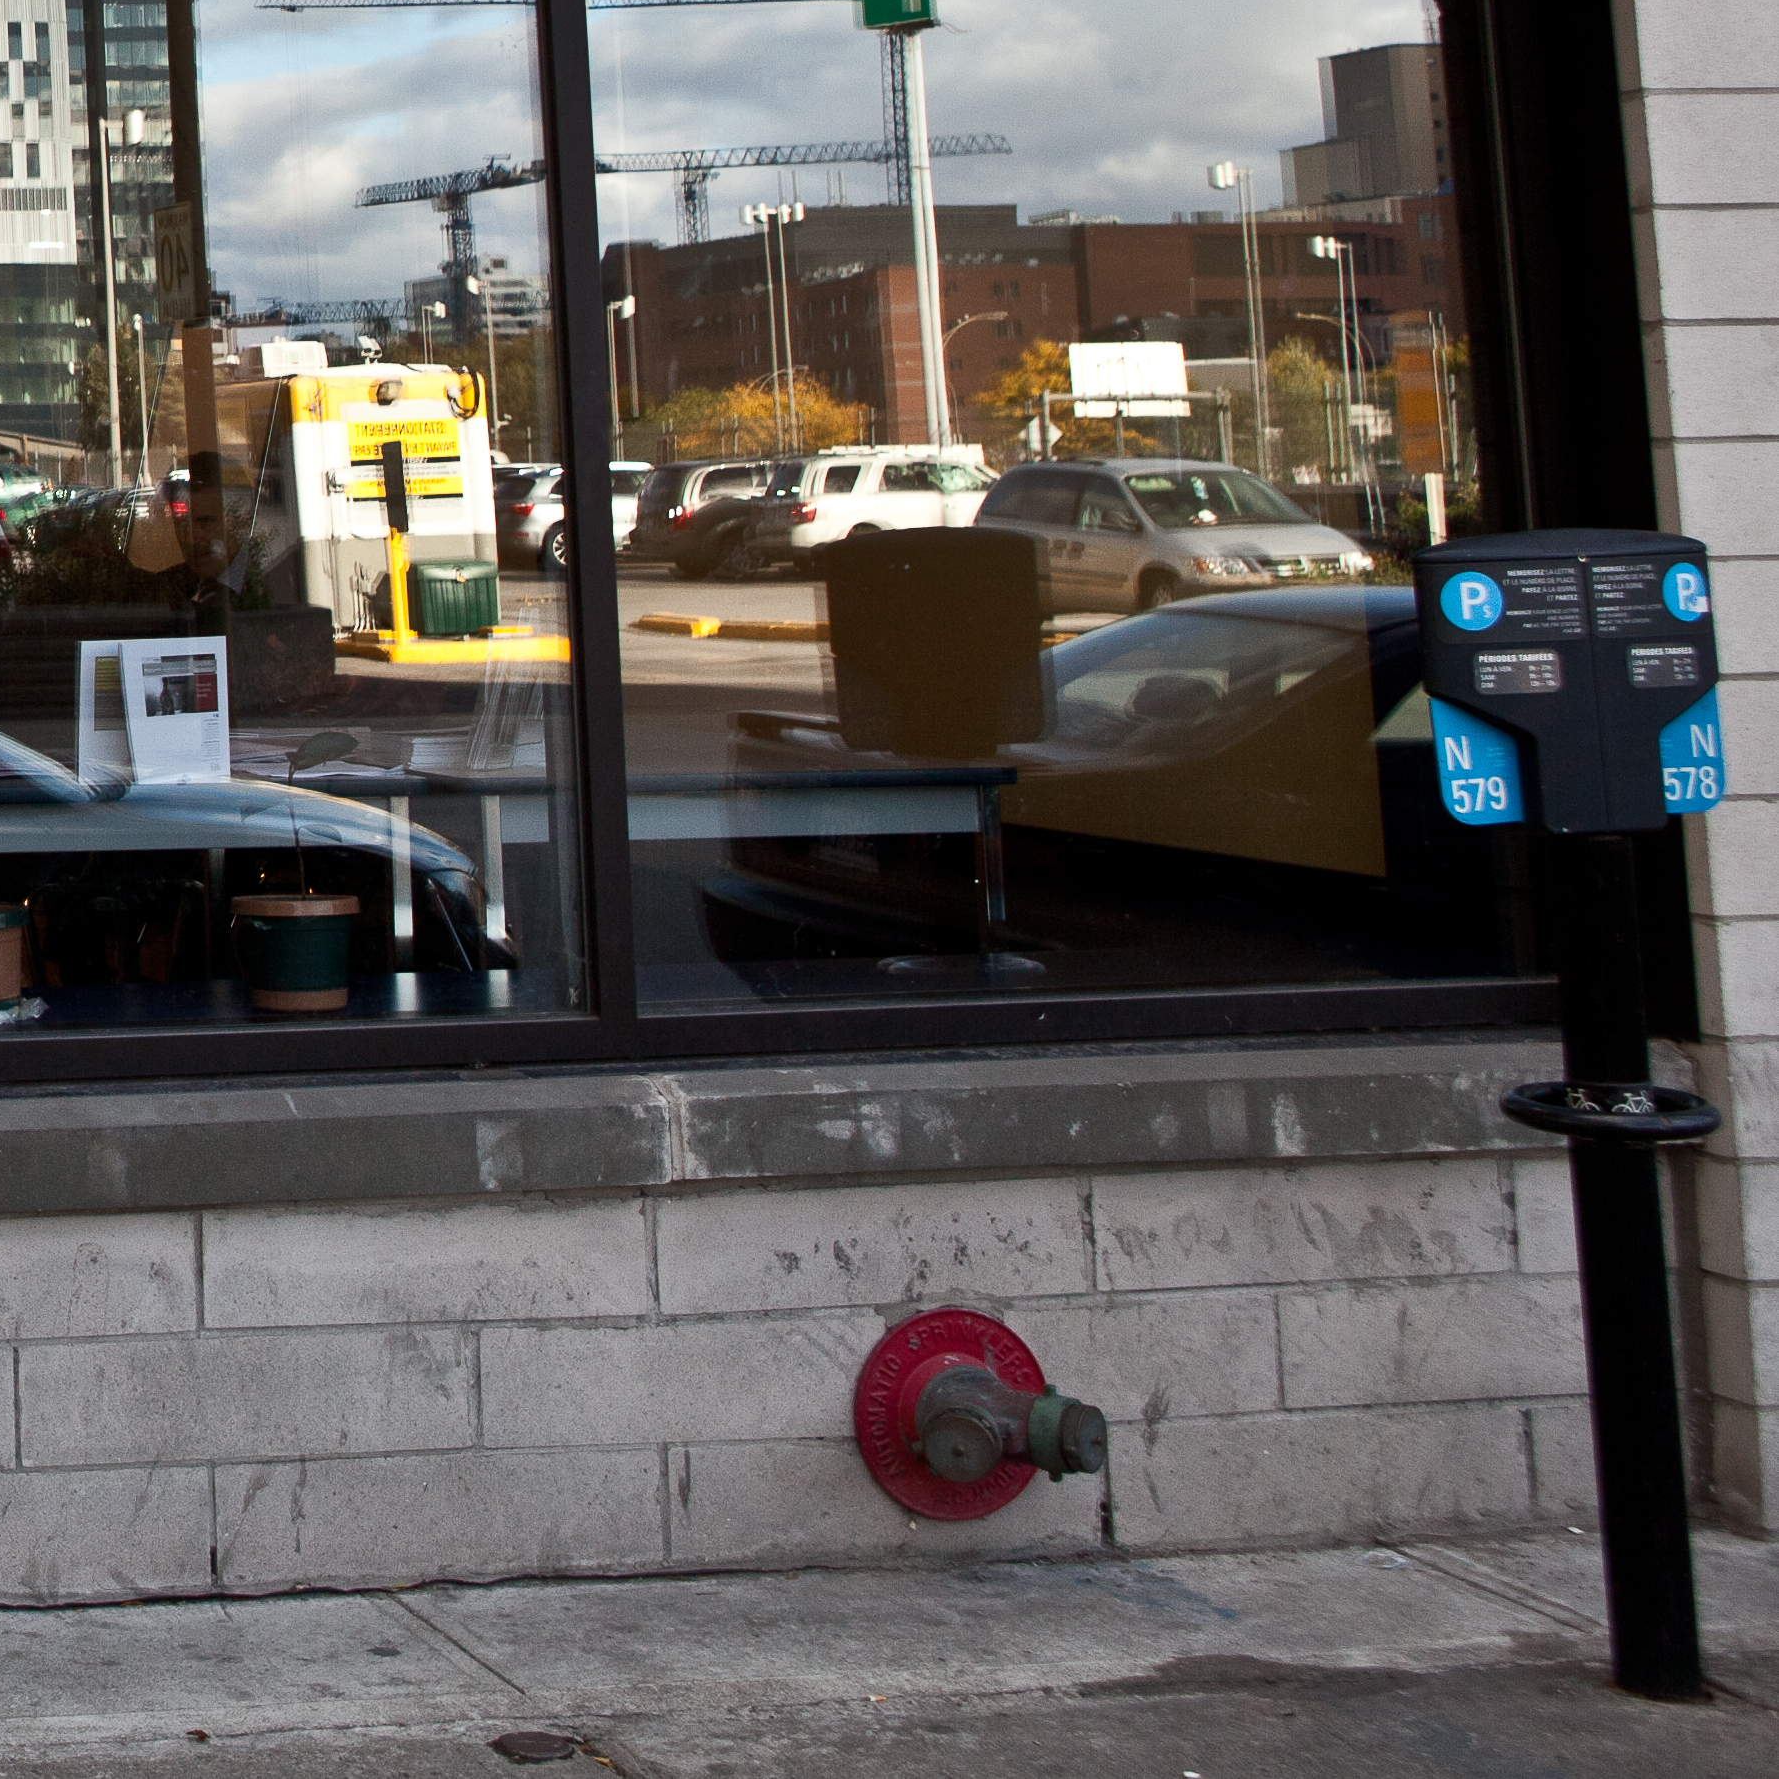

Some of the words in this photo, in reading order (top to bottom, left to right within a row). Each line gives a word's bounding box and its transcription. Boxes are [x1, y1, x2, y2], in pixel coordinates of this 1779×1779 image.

[1444, 735, 1473, 771] N
[1689, 723, 1718, 758] N
[1451, 776, 1509, 814] 579
[1662, 765, 1719, 801] 578
